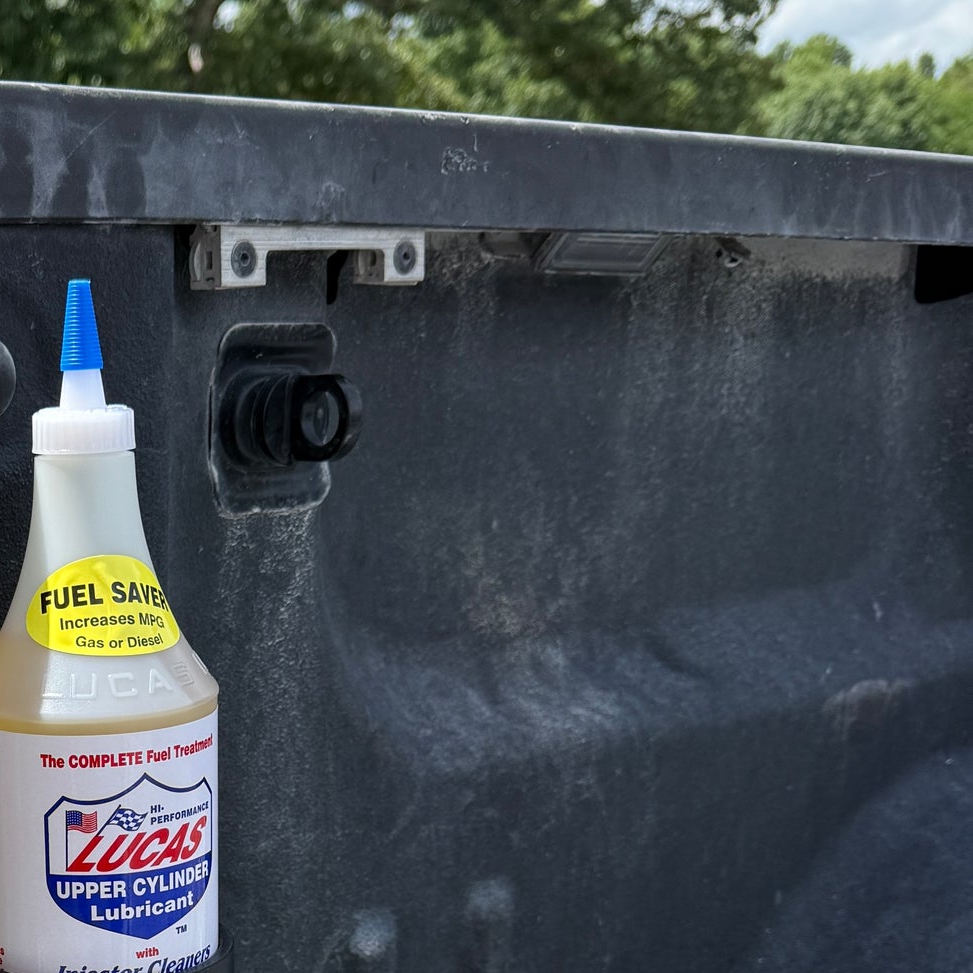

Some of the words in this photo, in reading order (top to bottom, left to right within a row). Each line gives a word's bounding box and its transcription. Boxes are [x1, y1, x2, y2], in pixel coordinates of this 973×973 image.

[40, 583, 104, 615] FUEL
[111, 581, 170, 613] SAVER
[60, 614, 135, 631] Increases
[138, 612, 165, 629] MPG
[75, 636, 105, 649] Gas
[109, 639, 124, 649] or
[127, 633, 164, 648] Diesel
[40, 754, 65, 769] The
[68, 750, 143, 769] COMPLETE
[146, 746, 171, 764] Fuel
[173, 733, 213, 759] Treatment
[150, 804, 165, 815] HI-
[150, 800, 210, 826] PERFORMANCE
[66, 815, 208, 873] LUCAS
[56, 880, 127, 900] UPPER
[132, 860, 210, 898] CYLINDER
[90, 890, 194, 922] Lubricant
[175, 924, 188, 935] TM
[135, 947, 160, 960] with
